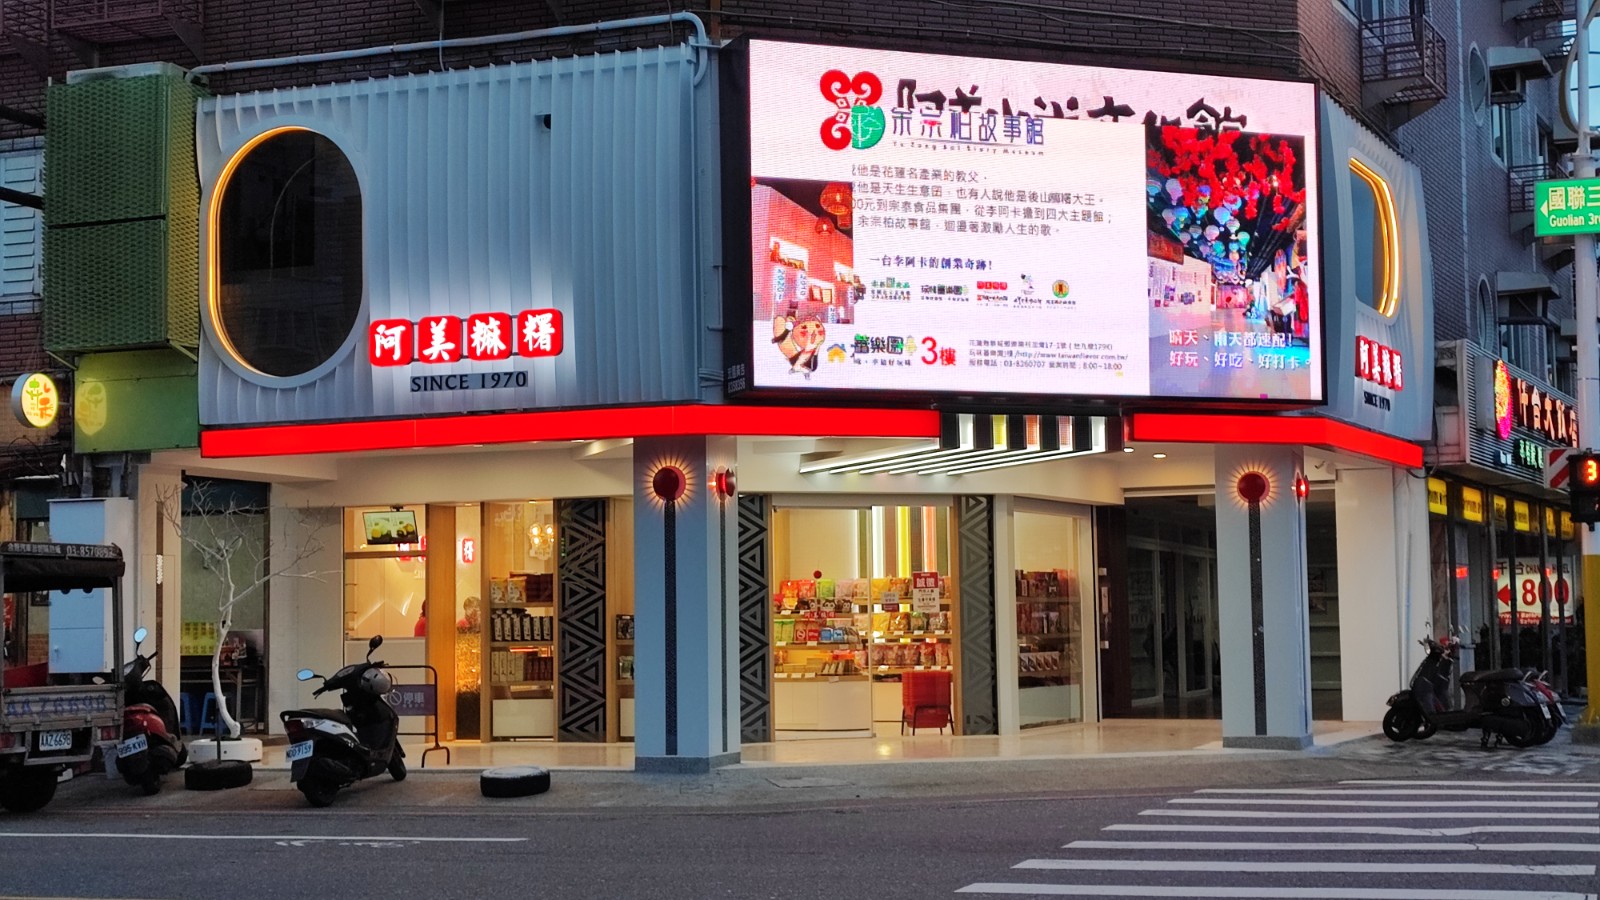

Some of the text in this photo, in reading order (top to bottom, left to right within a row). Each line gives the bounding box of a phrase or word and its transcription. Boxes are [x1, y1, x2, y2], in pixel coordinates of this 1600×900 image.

[1549, 186, 1600, 211] 國聯三
[1550, 212, 1600, 228] Guolian 3r
[411, 371, 527, 392] SINCE 1970
[1587, 459, 1598, 481] 3
